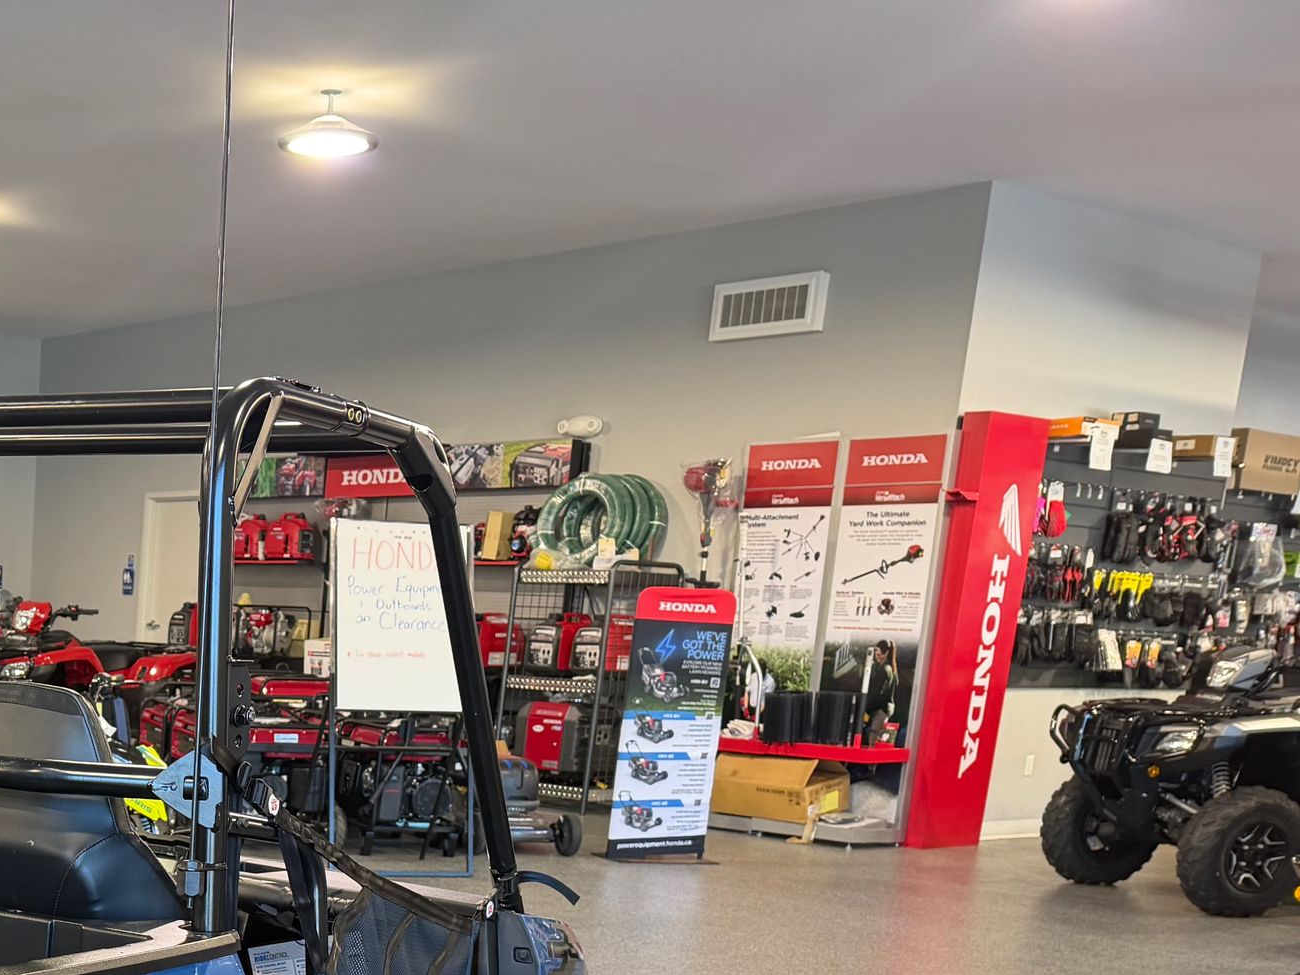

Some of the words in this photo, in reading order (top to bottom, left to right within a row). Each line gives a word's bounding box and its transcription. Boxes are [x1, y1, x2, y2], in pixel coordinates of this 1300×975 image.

[761, 458, 822, 471] HONDA
[861, 453, 928, 467] HONDA
[341, 467, 407, 487] HOND
[886, 520, 927, 528] Companion
[352, 537, 436, 571] HOND
[347, 574, 385, 595] Power
[376, 599, 432, 611] Outboards
[658, 601, 717, 614] HONDA
[380, 611, 446, 632] Clearance
[696, 630, 728, 641] WE'VE
[682, 639, 704, 650] GOT
[707, 640, 727, 652] THE
[687, 649, 725, 661] POWER
[958, 553, 1011, 779] HONDA
[617, 839, 693, 851] powerequipment.honda.ca
